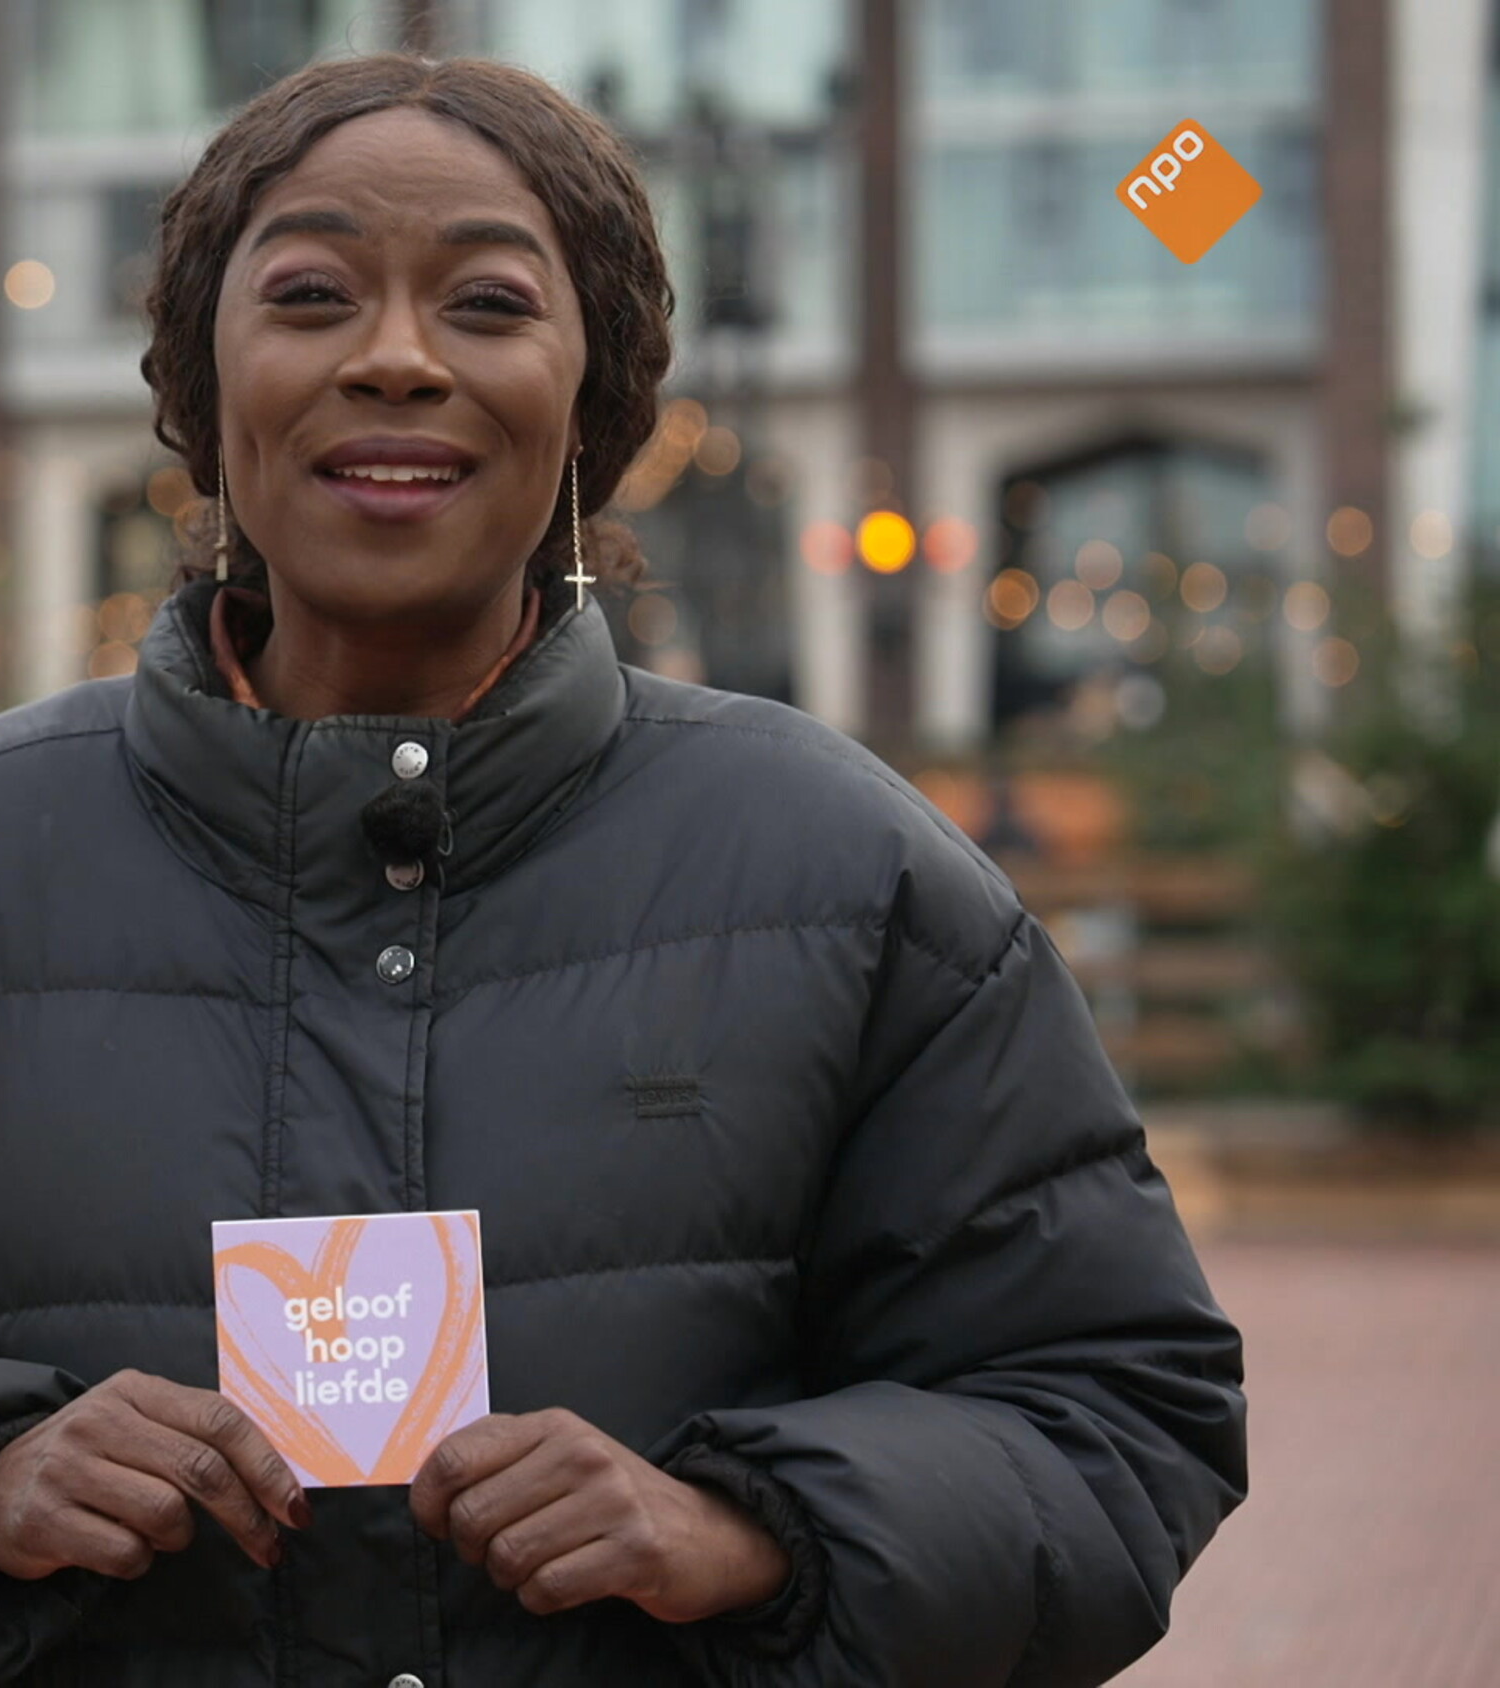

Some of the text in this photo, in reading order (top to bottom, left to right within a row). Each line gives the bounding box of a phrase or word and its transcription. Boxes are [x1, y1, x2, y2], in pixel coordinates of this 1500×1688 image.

[284, 1282, 412, 1331] geloof
[305, 1328, 405, 1369] hoop
[295, 1368, 409, 1406] liefde
